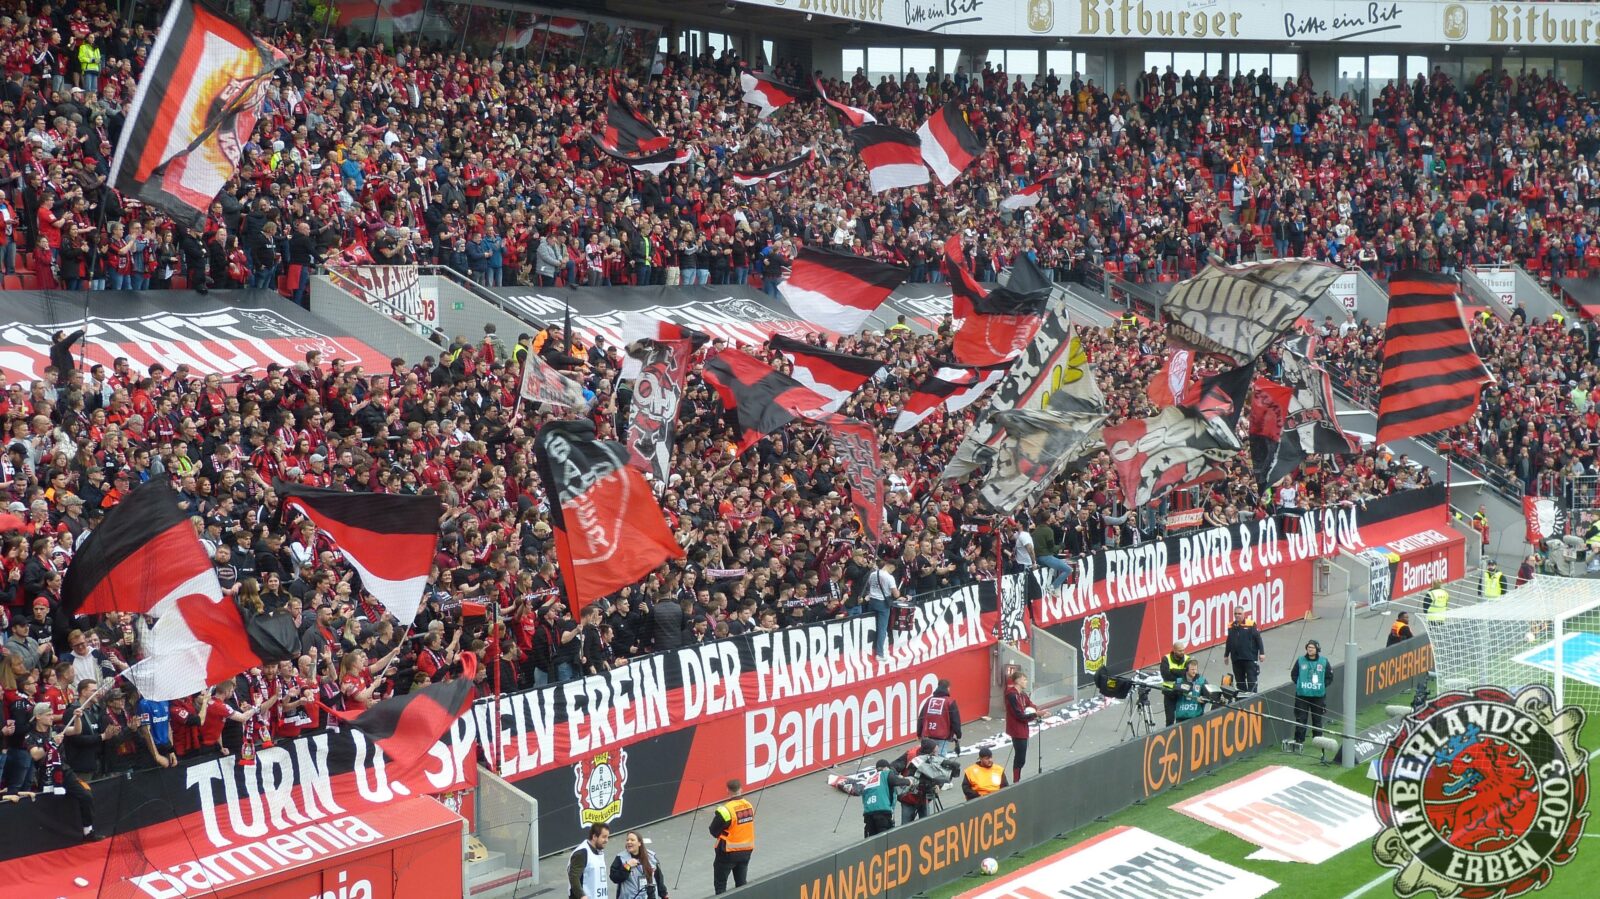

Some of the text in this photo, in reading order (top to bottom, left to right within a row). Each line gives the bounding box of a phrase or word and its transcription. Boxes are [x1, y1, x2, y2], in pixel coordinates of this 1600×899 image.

[905, 0, 983, 26] Bitte ein Bit
[1078, 0, 1243, 38] Bitburger
[1284, 2, 1403, 38] Bitte ein Bit
[1487, 5, 1600, 44] Bitbur
[1343, 297, 1355, 308] C3
[1501, 294, 1513, 305] C2
[1104, 541, 1176, 604] FRIEDR.
[1179, 527, 1235, 587] BAYER
[1239, 525, 1253, 573] &
[1258, 516, 1283, 567] CO.
[1402, 551, 1449, 593] Barmenia
[1172, 568, 1285, 650] Barmenia
[1300, 681, 1323, 692] HOST
[1365, 643, 1435, 696] IT SICHERHEIT
[1178, 702, 1199, 712] HOST
[186, 734, 347, 848] TURN
[351, 728, 411, 802] U.
[678, 640, 746, 721] DER
[745, 671, 939, 785] Barmenia
[1190, 701, 1264, 772] DITCON
[590, 780, 612, 794] BAYER
[584, 804, 619, 821] Leverkusen
[800, 802, 1018, 899] MANAGED SERVICES
